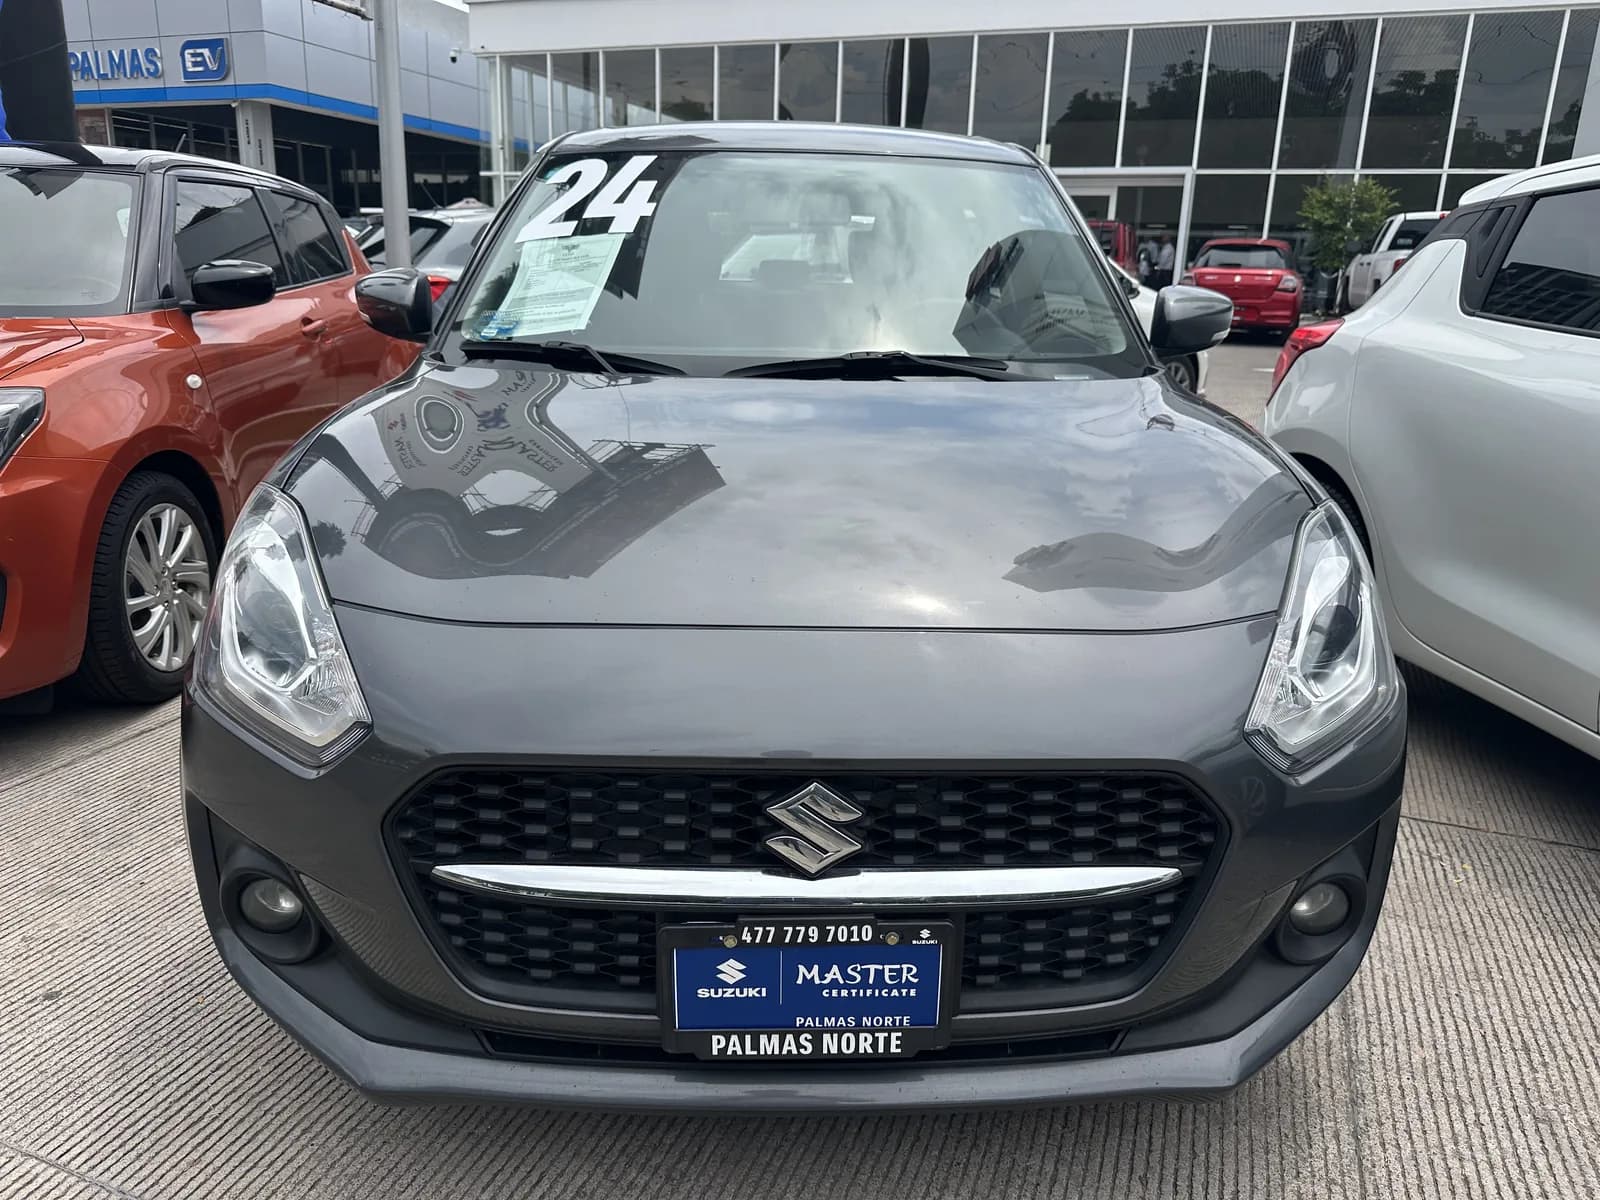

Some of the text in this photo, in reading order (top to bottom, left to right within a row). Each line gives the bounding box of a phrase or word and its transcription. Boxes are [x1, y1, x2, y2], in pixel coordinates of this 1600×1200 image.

[69, 46, 223, 81] PALMAS EV
[515, 155, 658, 243] 24
[741, 924, 873, 944] 477 779 7010
[795, 963, 920, 985] MASTER
[696, 987, 767, 998] SUZUKI
[822, 988, 917, 998] CERTIFICATE
[795, 1015, 912, 1028] PALMAS NORTE
[711, 1031, 903, 1056] PALMAS NORTE
